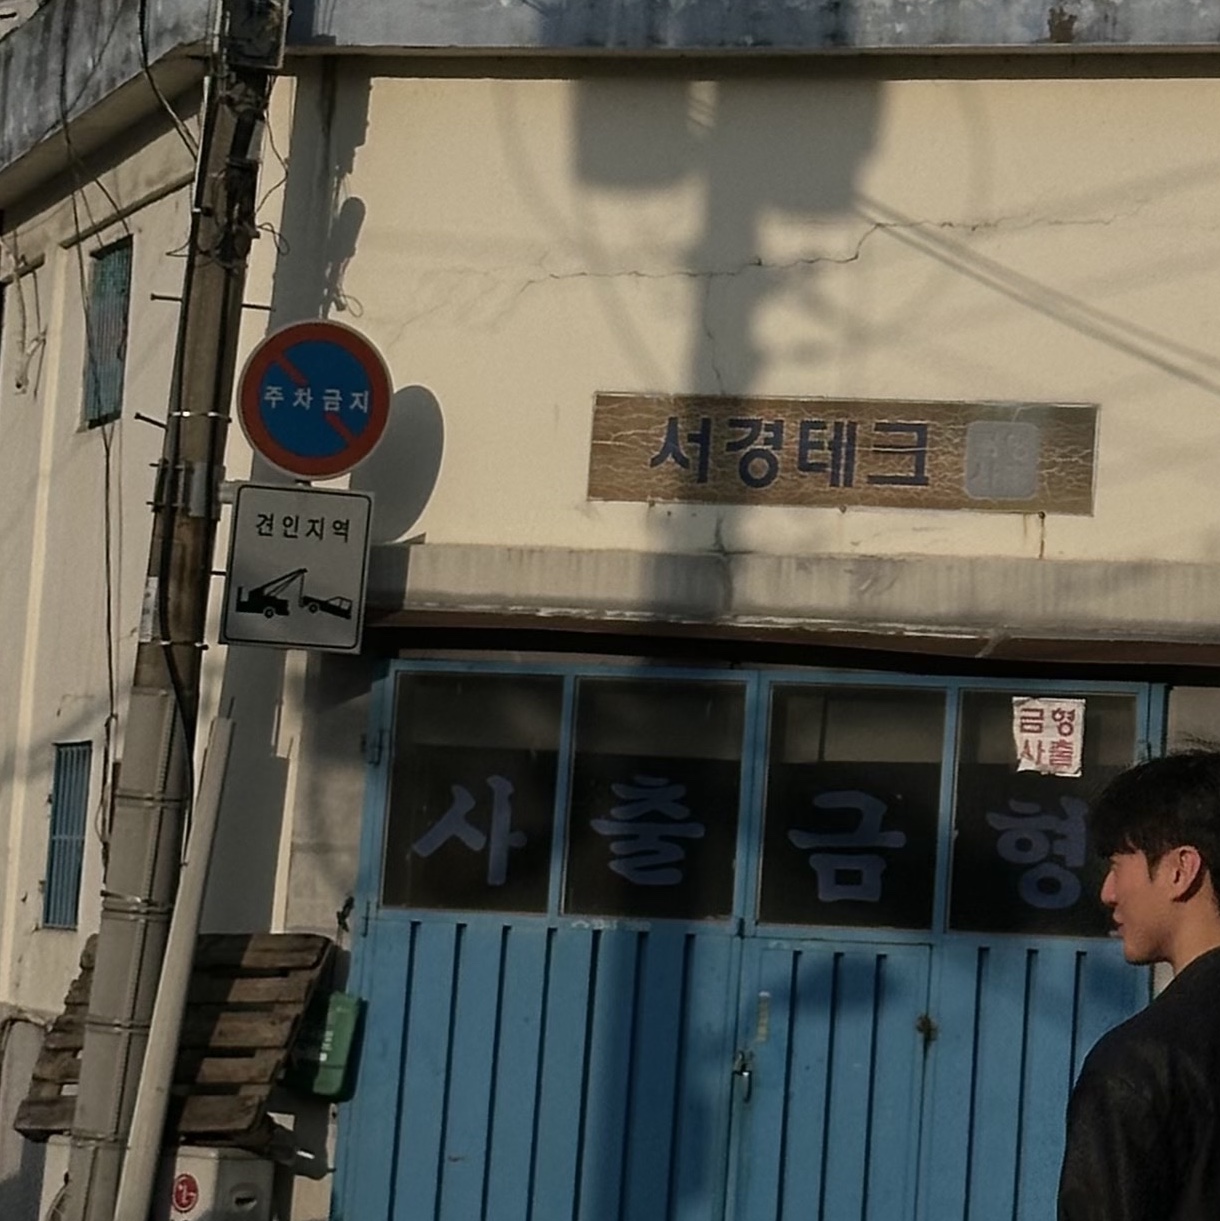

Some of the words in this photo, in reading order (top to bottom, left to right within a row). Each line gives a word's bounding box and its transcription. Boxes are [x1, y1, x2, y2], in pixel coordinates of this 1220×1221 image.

[263, 385, 370, 413] 주차금지
[649, 416, 930, 489] 서경테크
[256, 513, 350, 543] 견인지역
[1020, 708, 1075, 736] 금형
[1020, 739, 1074, 766] 사출
